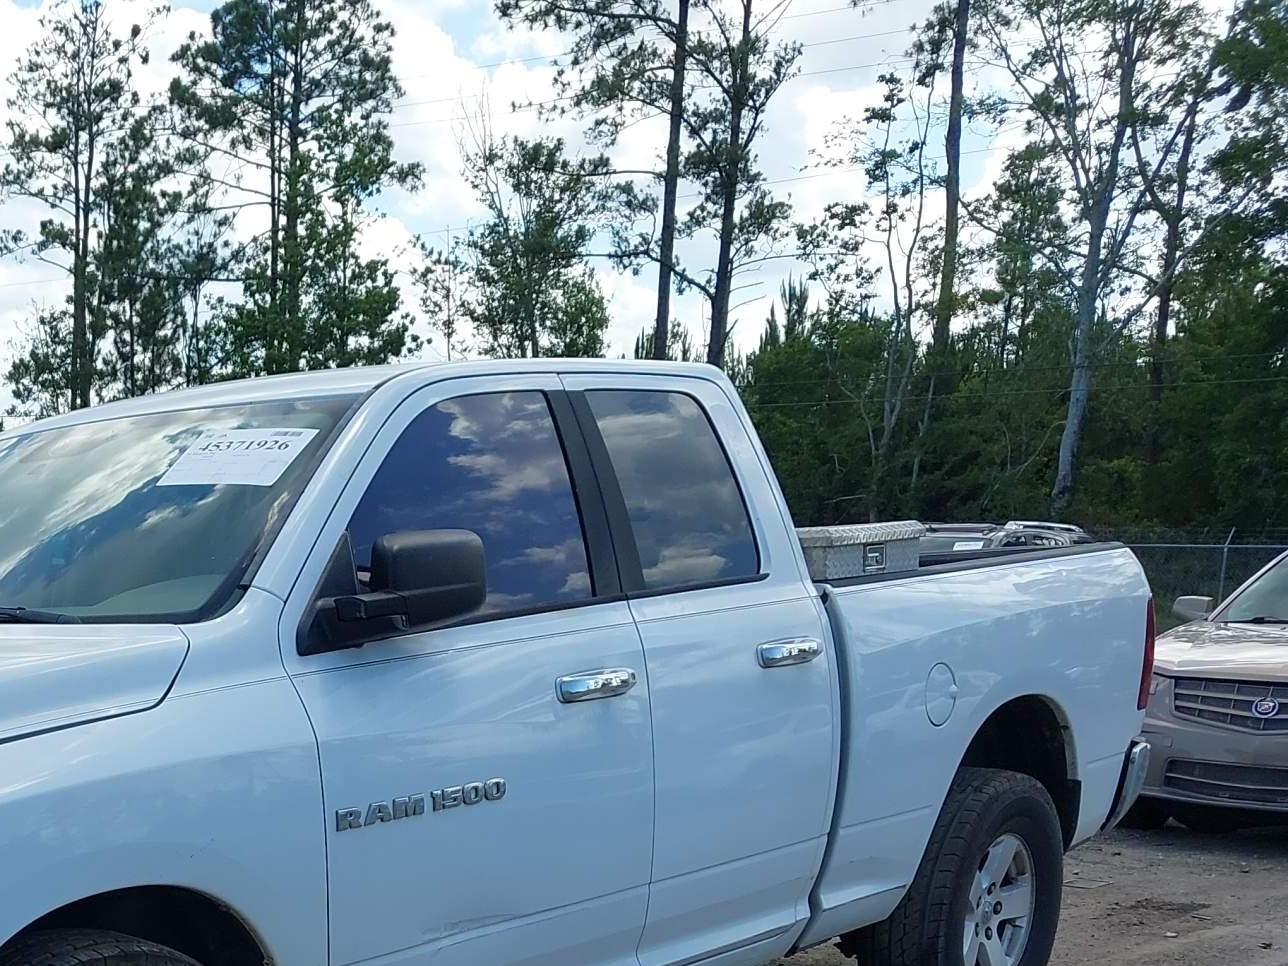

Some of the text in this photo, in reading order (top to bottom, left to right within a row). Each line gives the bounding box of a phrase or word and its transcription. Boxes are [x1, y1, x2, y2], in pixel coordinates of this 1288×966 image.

[199, 440, 292, 452] 45371926
[336, 777, 507, 832] RAM 1500
